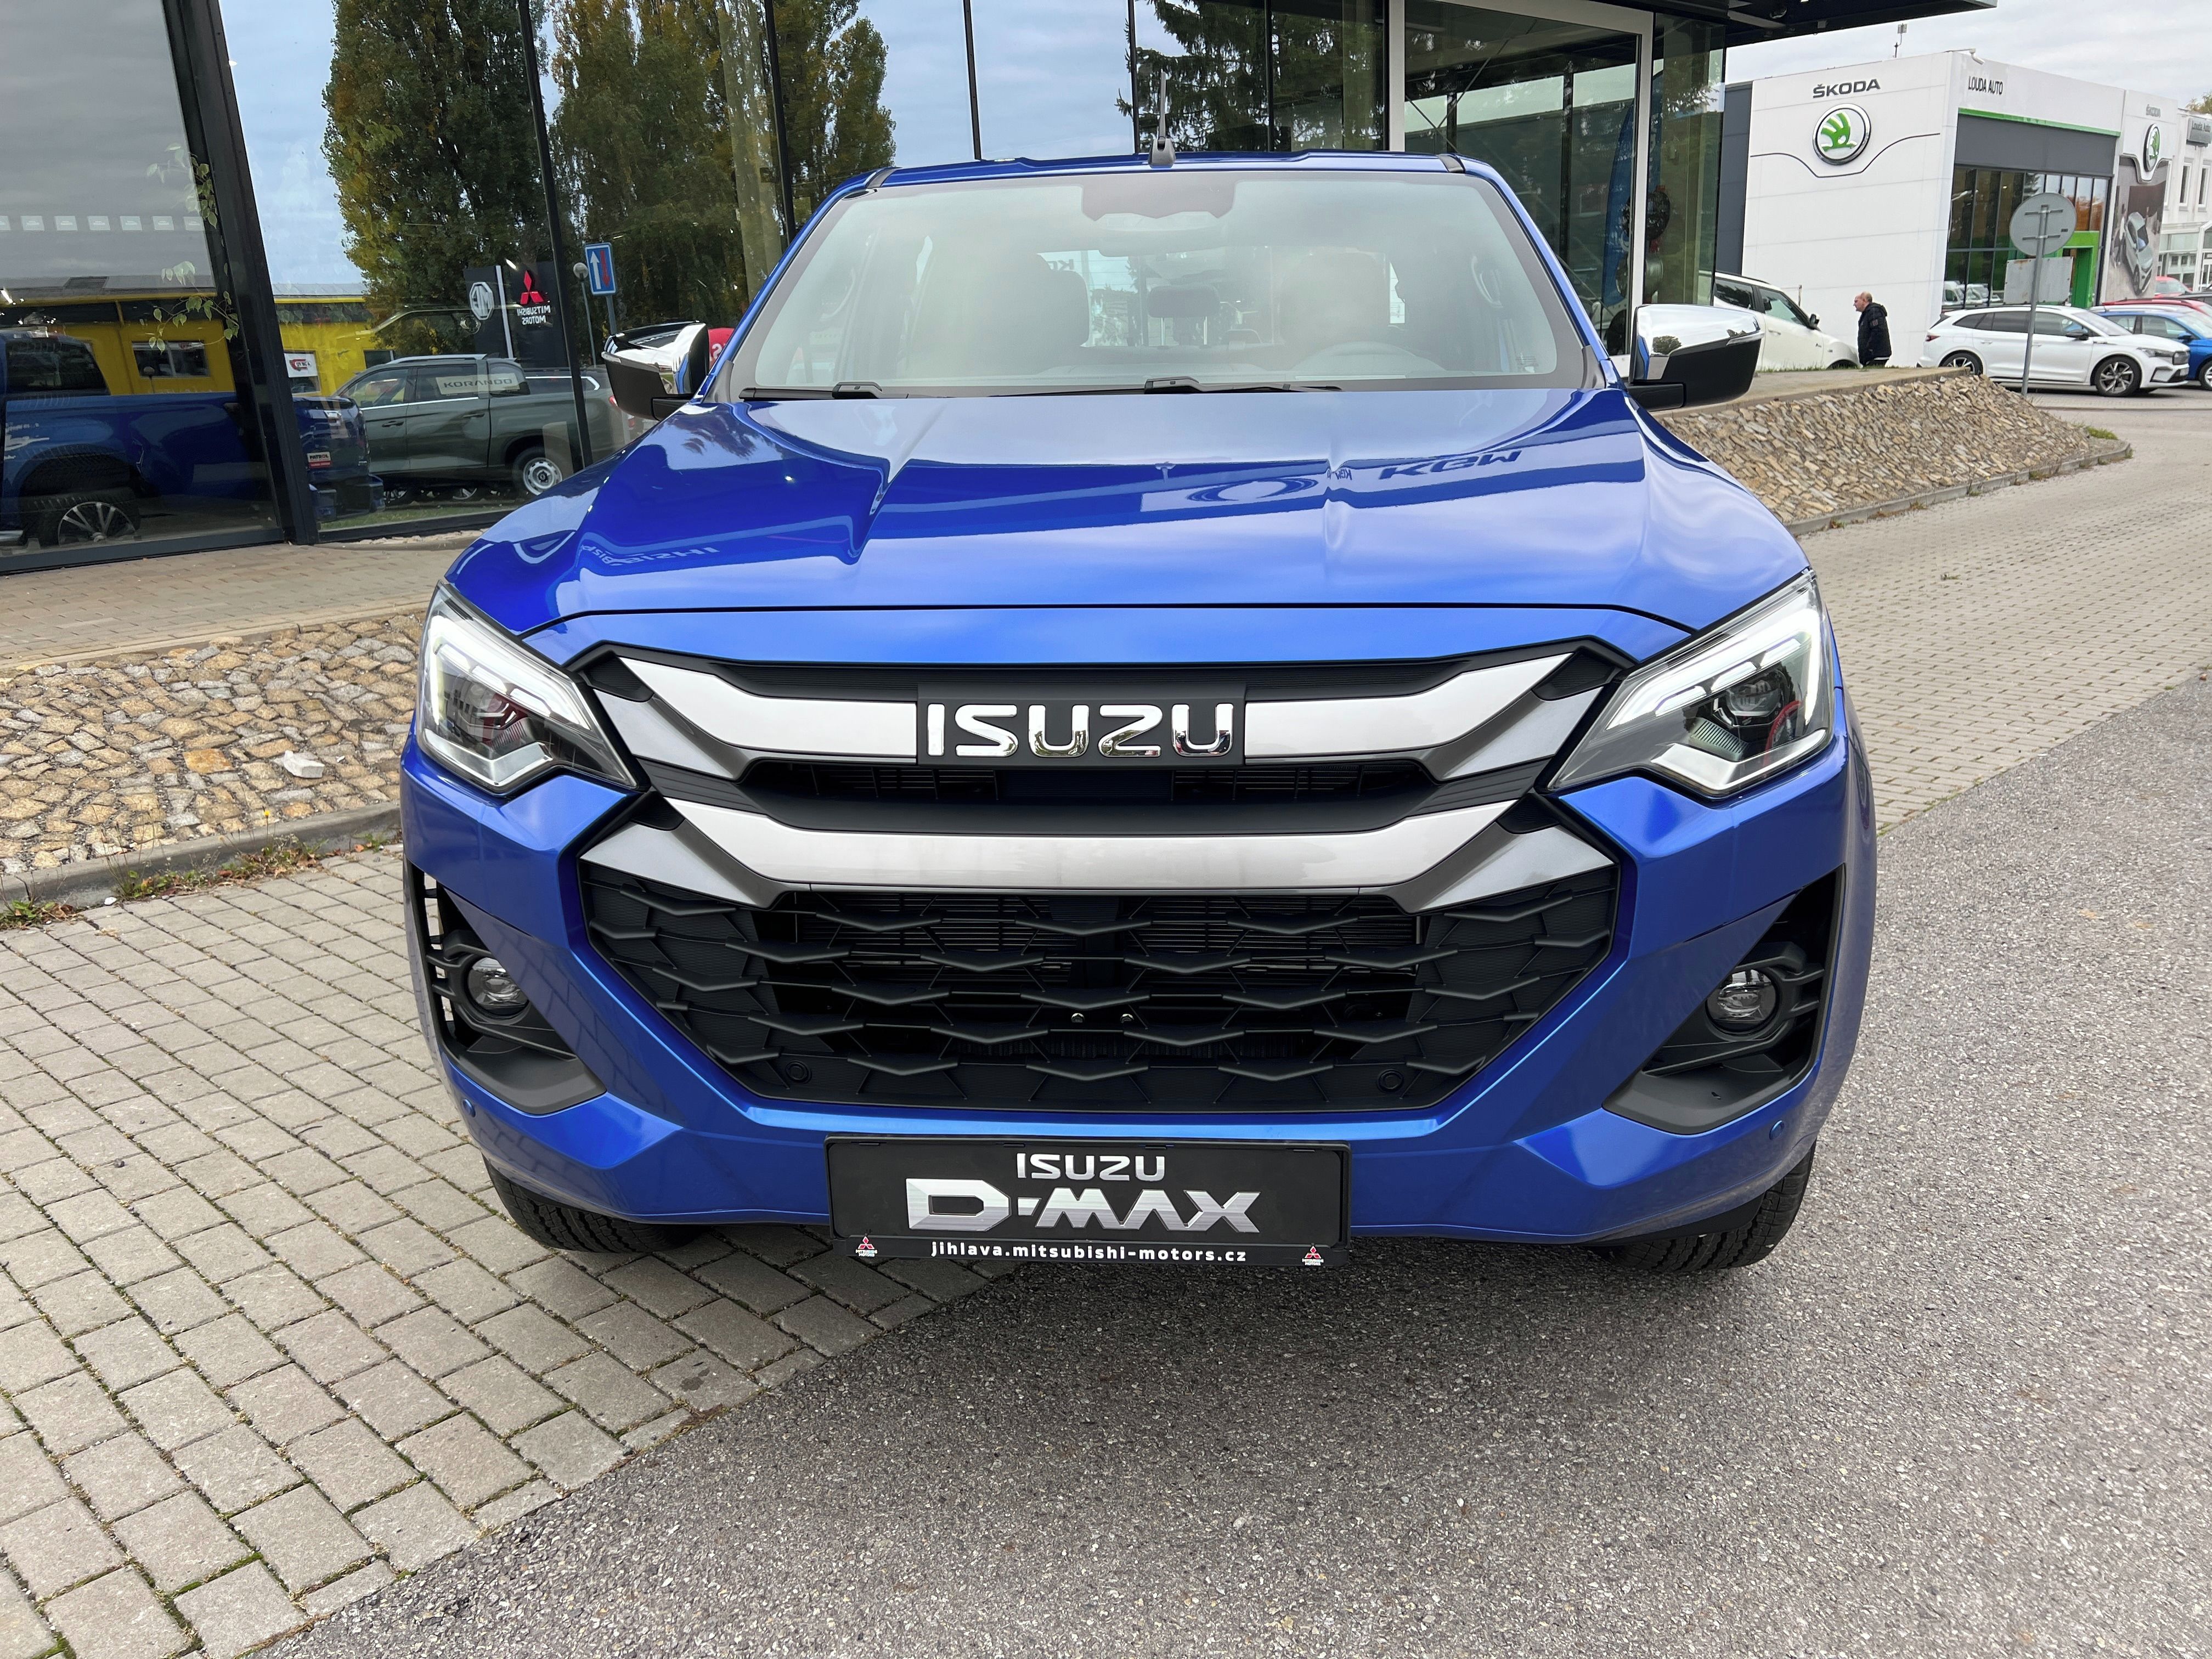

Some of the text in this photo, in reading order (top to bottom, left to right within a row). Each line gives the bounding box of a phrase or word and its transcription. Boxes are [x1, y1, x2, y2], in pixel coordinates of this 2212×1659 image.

[1813, 78, 1881, 98] ŠKODA
[1968, 76, 2003, 95] LOUDA AUTO
[444, 379, 512, 388] KORANDO
[928, 704, 1234, 758] ISUZU
[1017, 1153, 1165, 1181] ISUZU
[906, 1178, 1260, 1233] D-MAX
[931, 1242, 1246, 1262] jihlava.mitsubishi-motors.cz
